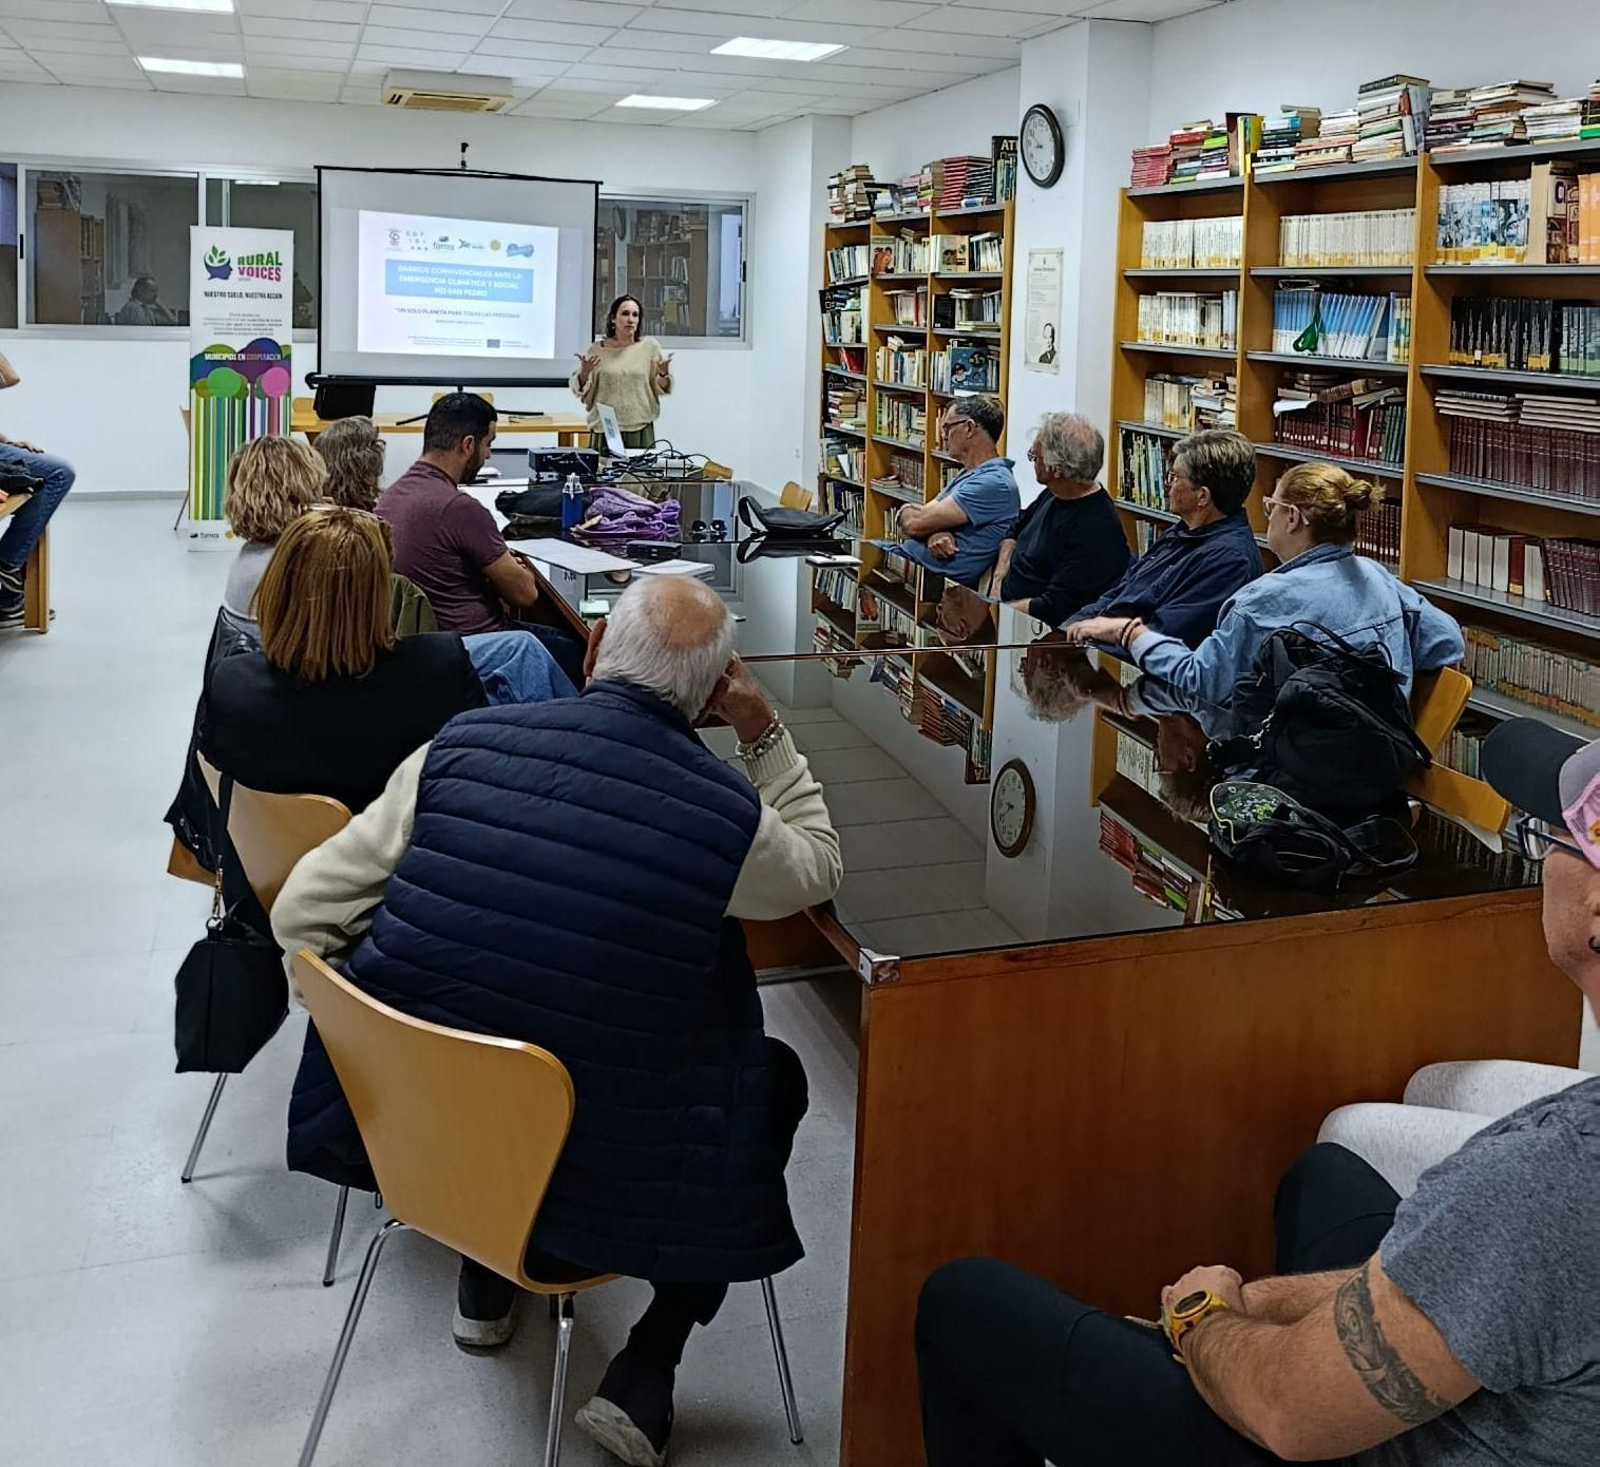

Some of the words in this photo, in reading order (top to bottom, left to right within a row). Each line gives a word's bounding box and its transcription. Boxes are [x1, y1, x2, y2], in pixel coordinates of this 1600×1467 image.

[237, 251, 283, 266] RURAL
[238, 266, 281, 282] VOICES
[398, 275, 446, 284] EMERGENCIA
